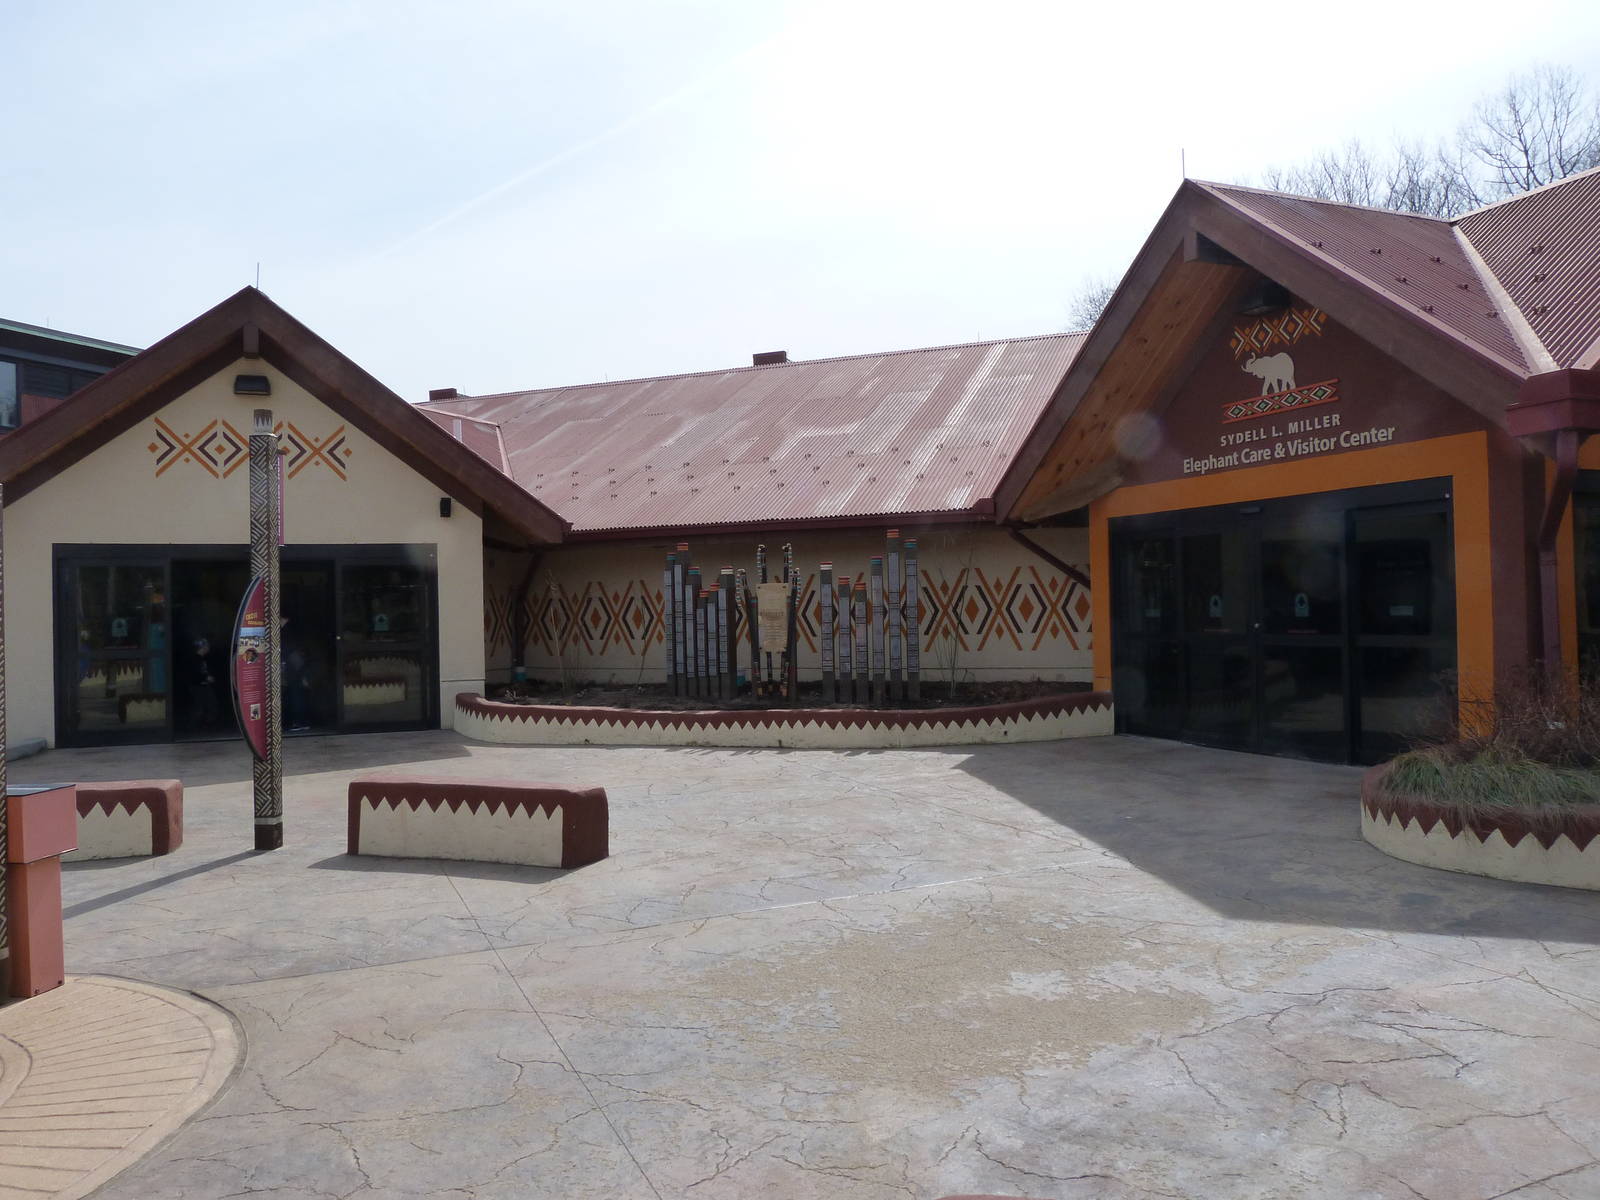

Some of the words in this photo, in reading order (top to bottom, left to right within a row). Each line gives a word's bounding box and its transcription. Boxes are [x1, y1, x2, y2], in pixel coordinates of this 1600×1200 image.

[1183, 451, 1239, 474] Elephant
[1241, 447, 1271, 464] Care
[1274, 443, 1285, 459] &
[1286, 435, 1337, 456] Visitor
[1339, 426, 1396, 448] Center
[1220, 429, 1267, 447] SYDELL
[1271, 425, 1283, 437] L.
[1288, 413, 1341, 434] MILLER
